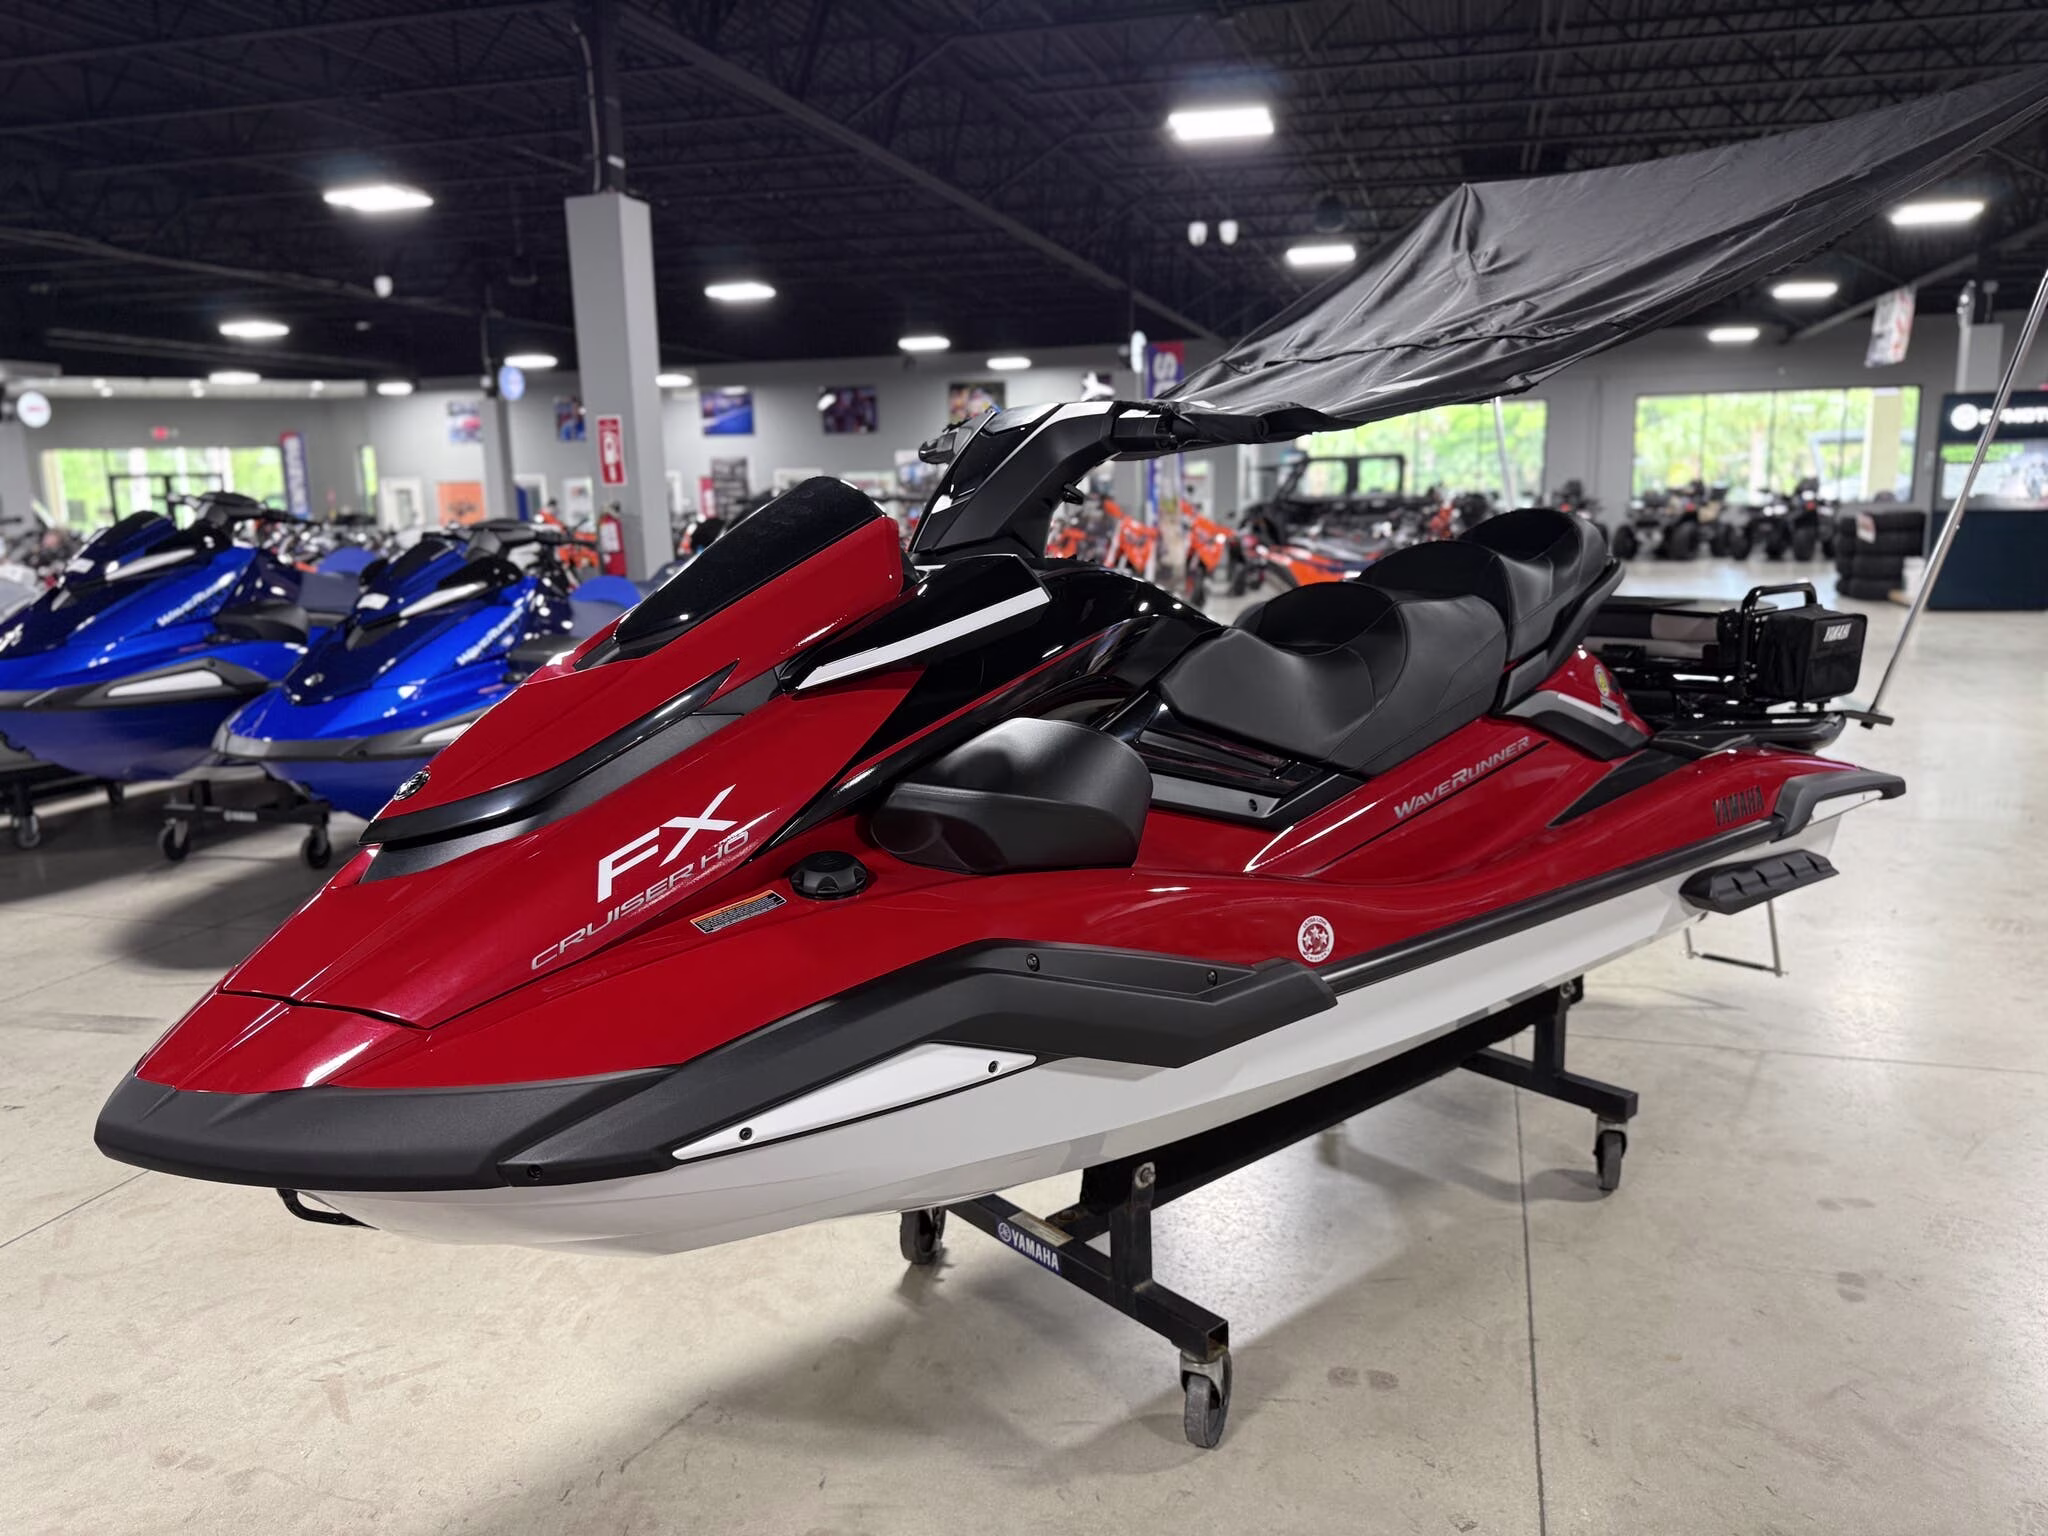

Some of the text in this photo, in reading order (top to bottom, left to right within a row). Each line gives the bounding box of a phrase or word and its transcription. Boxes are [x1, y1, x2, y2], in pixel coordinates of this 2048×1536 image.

[598, 783, 739, 903] FX
[1712, 785, 1764, 827] YAMAHA
[531, 862, 695, 970] CRUISER
[700, 830, 749, 869] HO
[1012, 1228, 1060, 1271] YAMAHA
